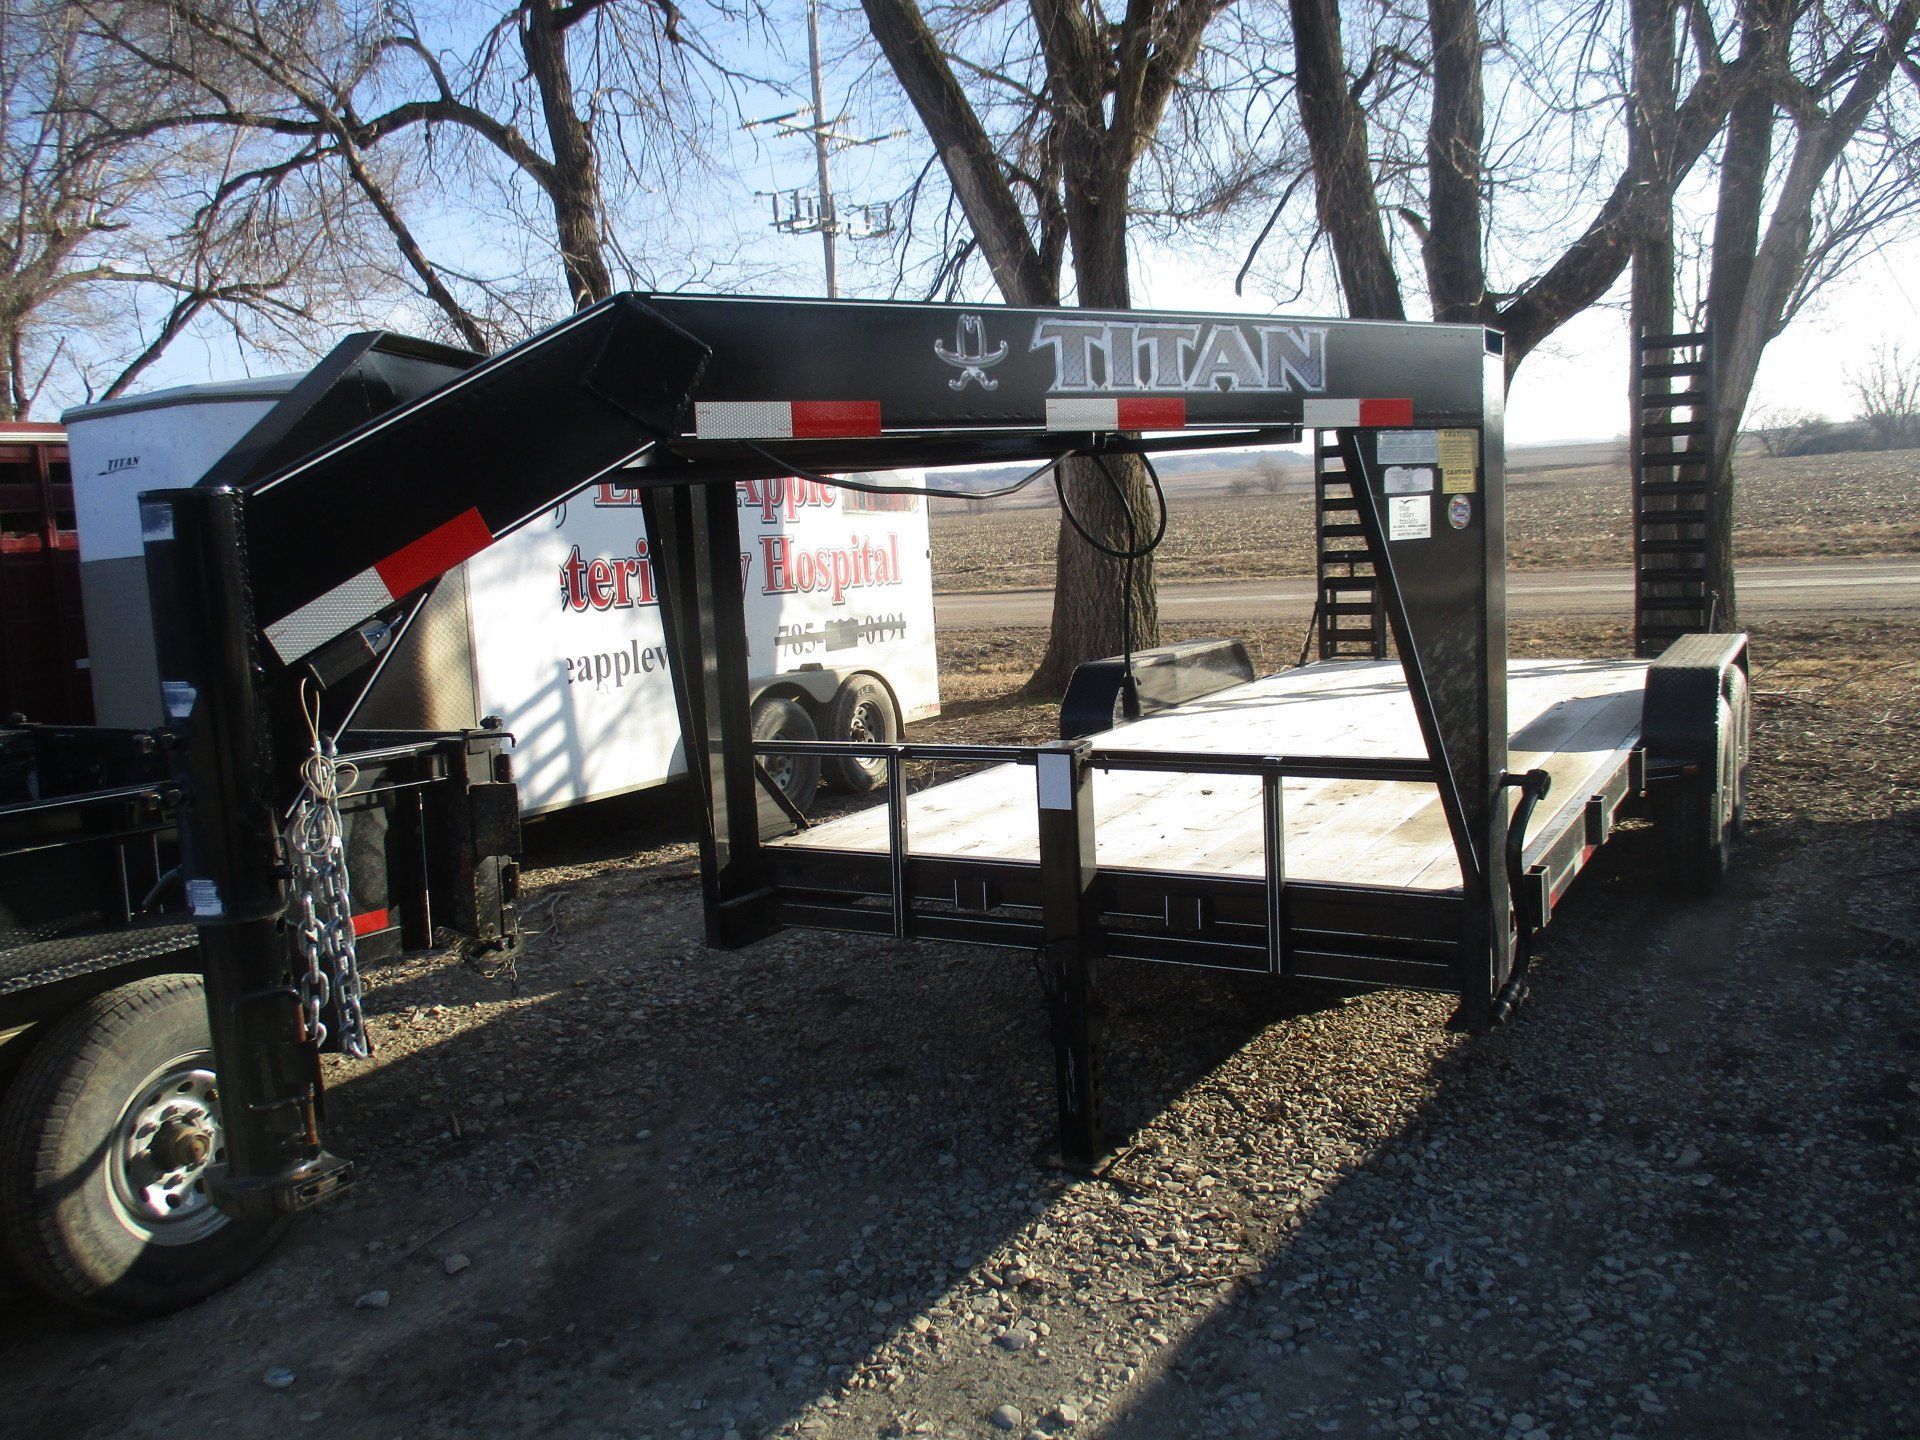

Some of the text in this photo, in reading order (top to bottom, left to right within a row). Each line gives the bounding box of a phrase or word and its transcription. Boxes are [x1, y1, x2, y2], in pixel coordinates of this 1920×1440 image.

[1029, 317, 1330, 393] TITAN
[107, 456, 140, 471] TITAN
[758, 532, 902, 605] Hospital
